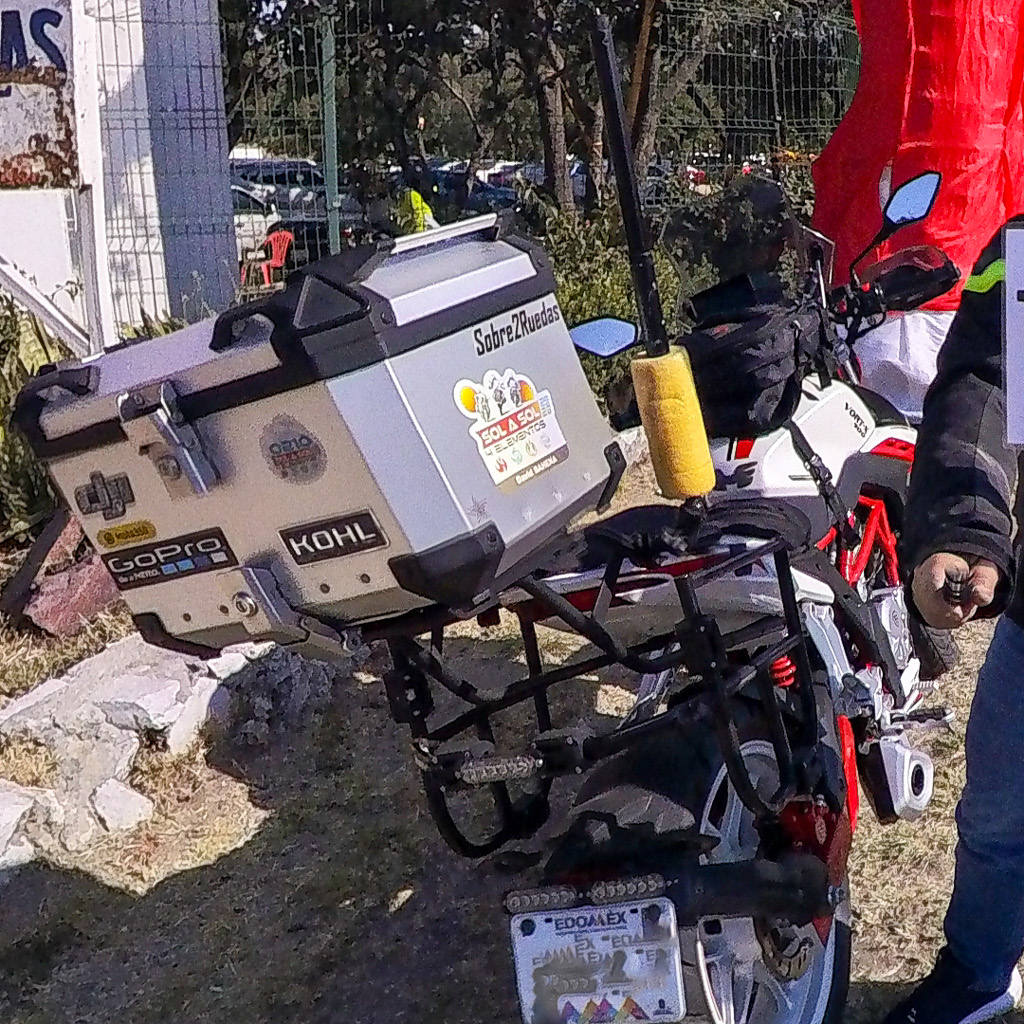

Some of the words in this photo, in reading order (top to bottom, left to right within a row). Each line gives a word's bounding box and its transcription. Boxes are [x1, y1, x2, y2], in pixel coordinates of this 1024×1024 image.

[473, 301, 560, 356] Sobre2Ruedas
[480, 426, 508, 445] SOL
[507, 418, 519, 433] A
[517, 406, 540, 426] SOL
[107, 536, 222, 574] GoPro
[288, 521, 377, 557] KOHL
[554, 910, 628, 931] EDOMEX
